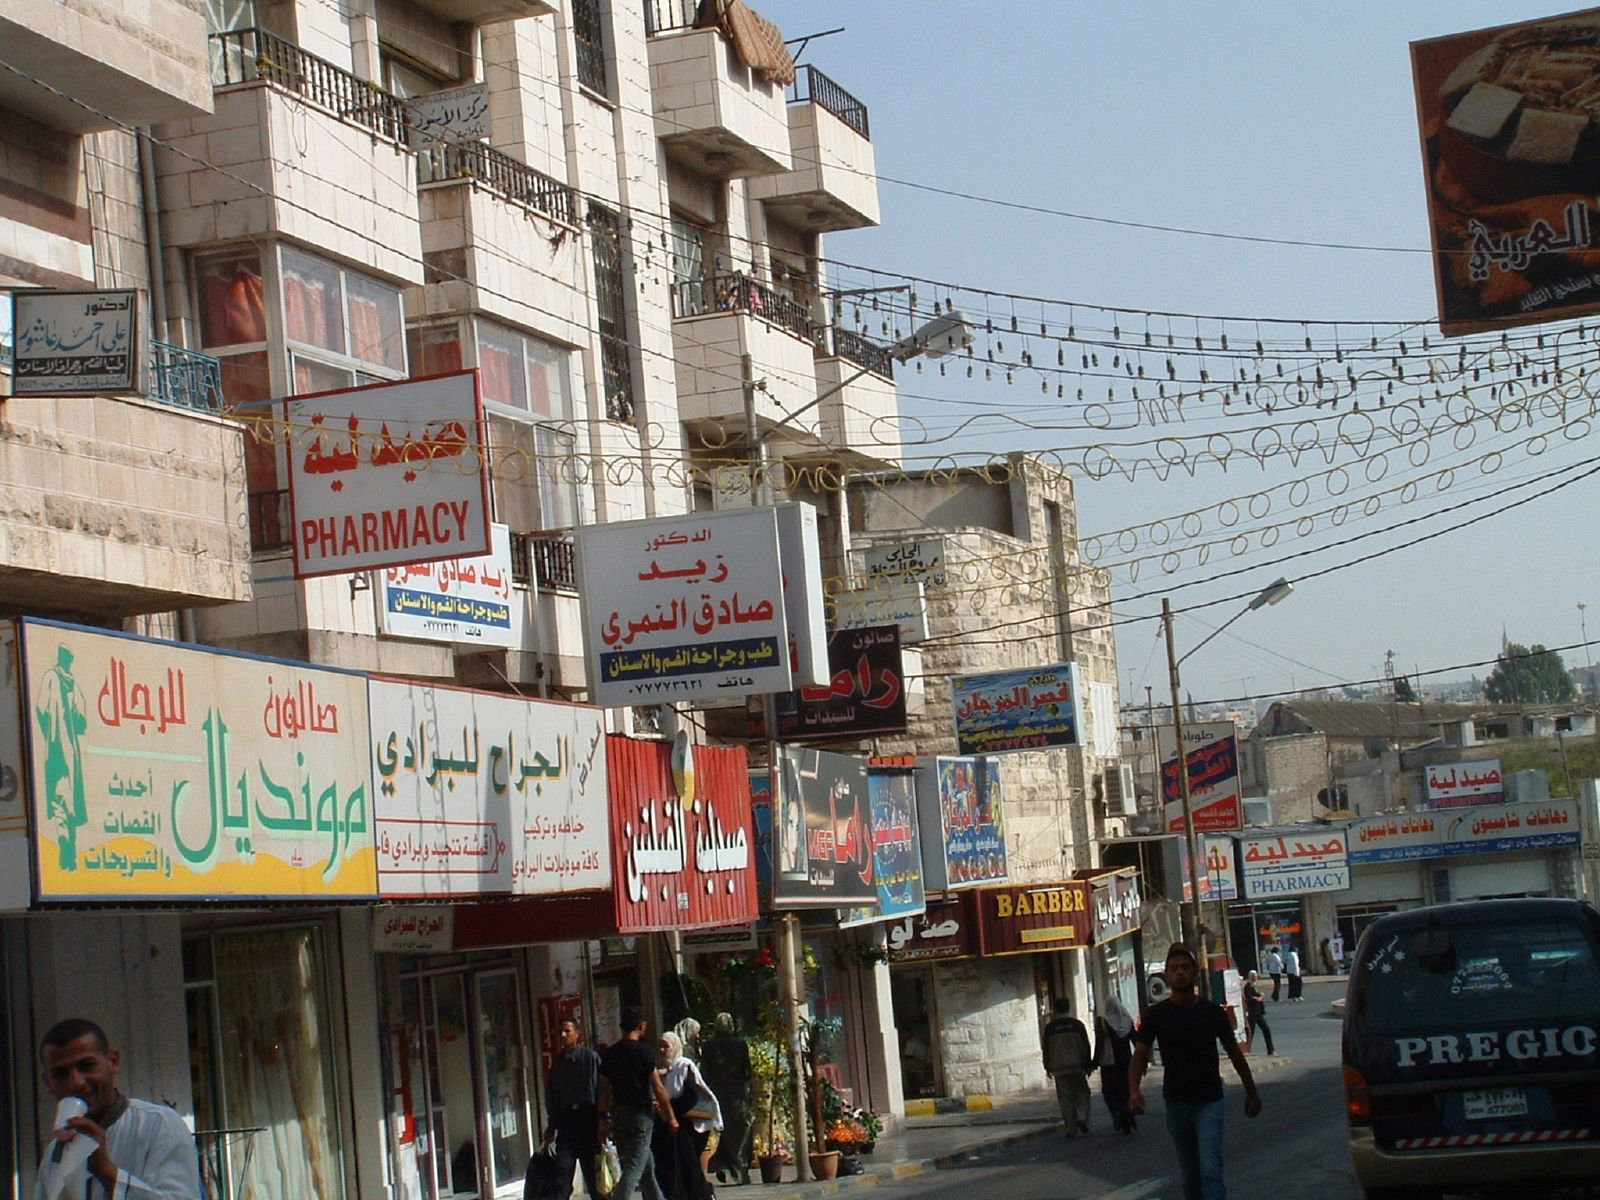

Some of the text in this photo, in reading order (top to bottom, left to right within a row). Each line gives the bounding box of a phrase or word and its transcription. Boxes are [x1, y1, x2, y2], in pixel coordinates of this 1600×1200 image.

[101, 320, 126, 353] علي
[304, 412, 469, 493] صيدلية
[301, 500, 469, 560] PHARMACY
[645, 529, 711, 551] الدكتور
[481, 563, 509, 600] زيد
[638, 554, 728, 583] زيد
[436, 596, 458, 616] الفم
[491, 606, 507, 622] طب
[601, 592, 774, 651] صادق النمري
[852, 632, 894, 649] صالون
[610, 642, 772, 677] طب وجراحة الفم والاسنان
[717, 676, 754, 688] هاتف
[801, 654, 899, 708] رام
[98, 656, 338, 738] صالون للرجال
[377, 720, 569, 797] الجراح للبرادي
[109, 767, 153, 797] أحدث
[172, 706, 367, 877] مونديال
[1430, 768, 1500, 794] صيدلية
[104, 810, 160, 834] القصات
[1402, 817, 1434, 835] دهانات
[1472, 808, 1569, 835] دهانات شامبيون
[695, 799, 748, 895] صيدلية
[1245, 837, 1343, 865] صيدلية
[86, 847, 170, 879] والتسريحات
[1251, 872, 1345, 894] PHARMACY
[995, 888, 1085, 918] BARBER
[1395, 1025, 1598, 1067] PREGIO
